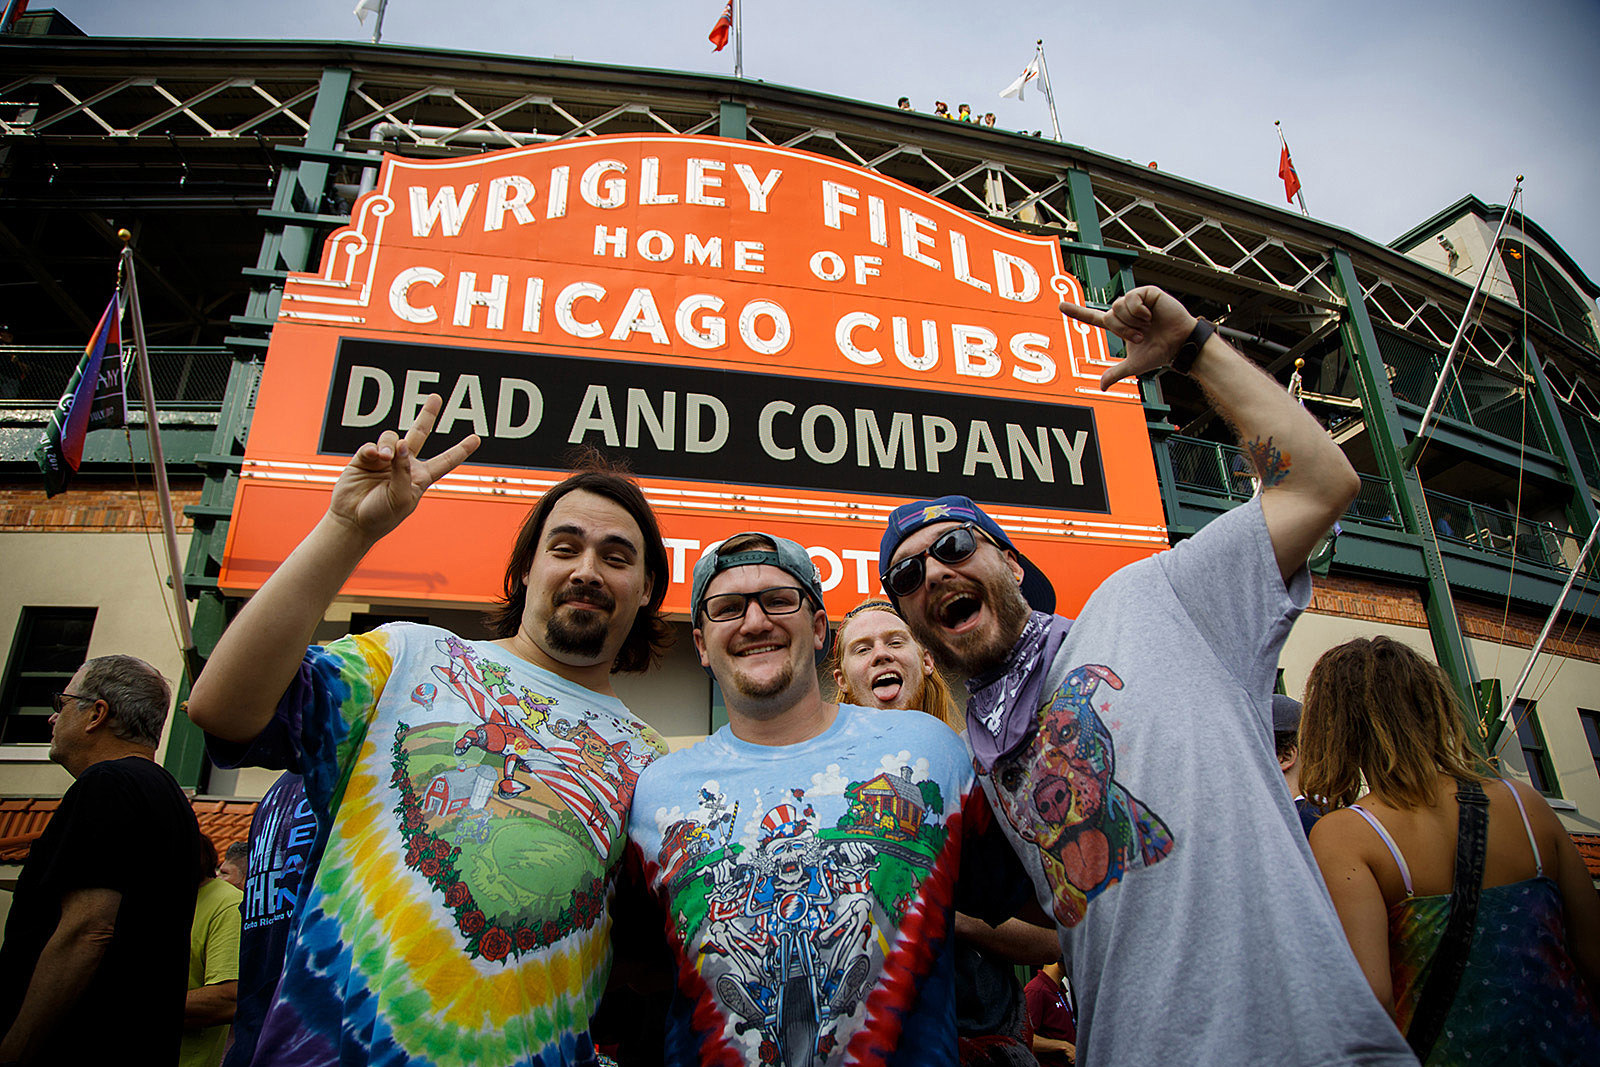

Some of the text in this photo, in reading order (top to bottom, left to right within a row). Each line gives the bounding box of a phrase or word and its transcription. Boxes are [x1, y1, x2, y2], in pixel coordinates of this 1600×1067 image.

[408, 156, 1041, 303] WRIGLEY FIELD
[593, 224, 883, 286] HOME OF
[388, 266, 1058, 384] CHICAGO CUBS
[341, 365, 1089, 486] DEAD AND COMPANY
